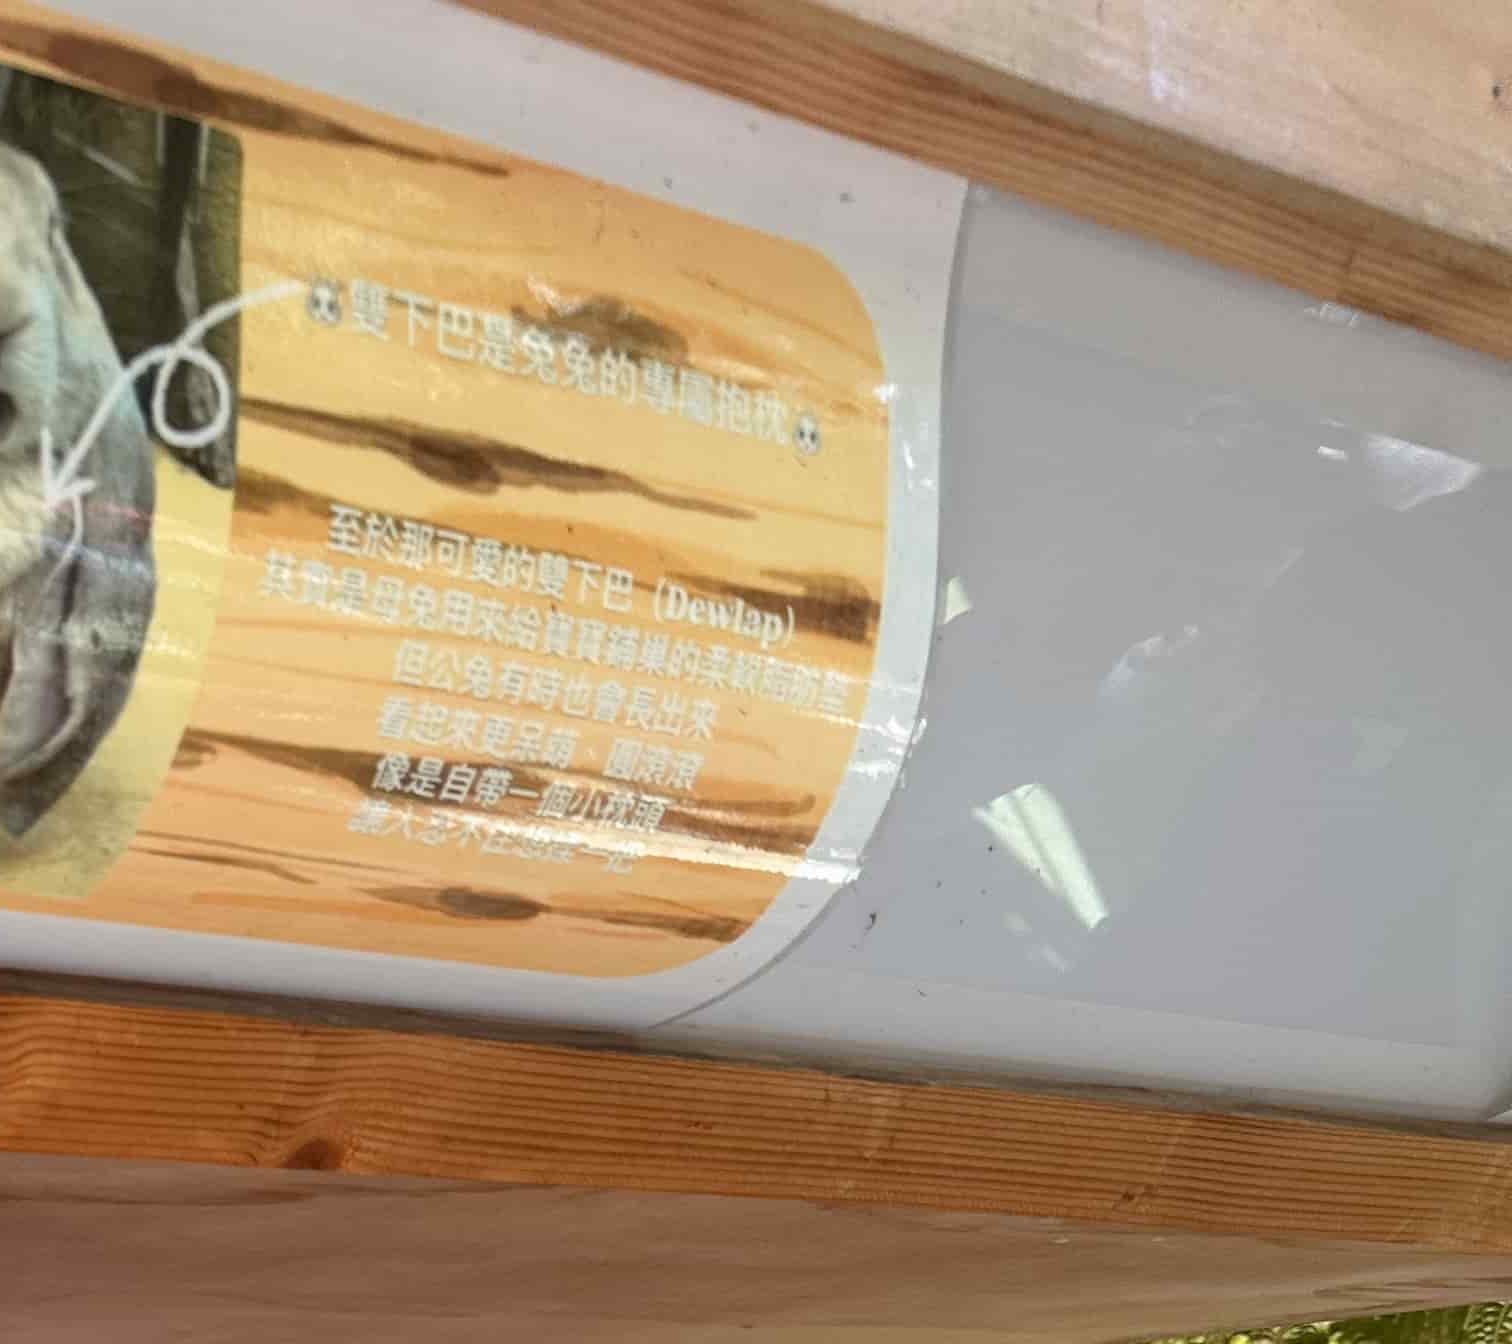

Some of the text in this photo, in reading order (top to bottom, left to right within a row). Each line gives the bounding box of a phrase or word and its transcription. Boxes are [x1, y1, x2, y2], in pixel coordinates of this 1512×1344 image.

[327, 502, 633, 613] 至於那可愛的雙下巴
[371, 751, 669, 833] 像是自帶一個小枕頭
